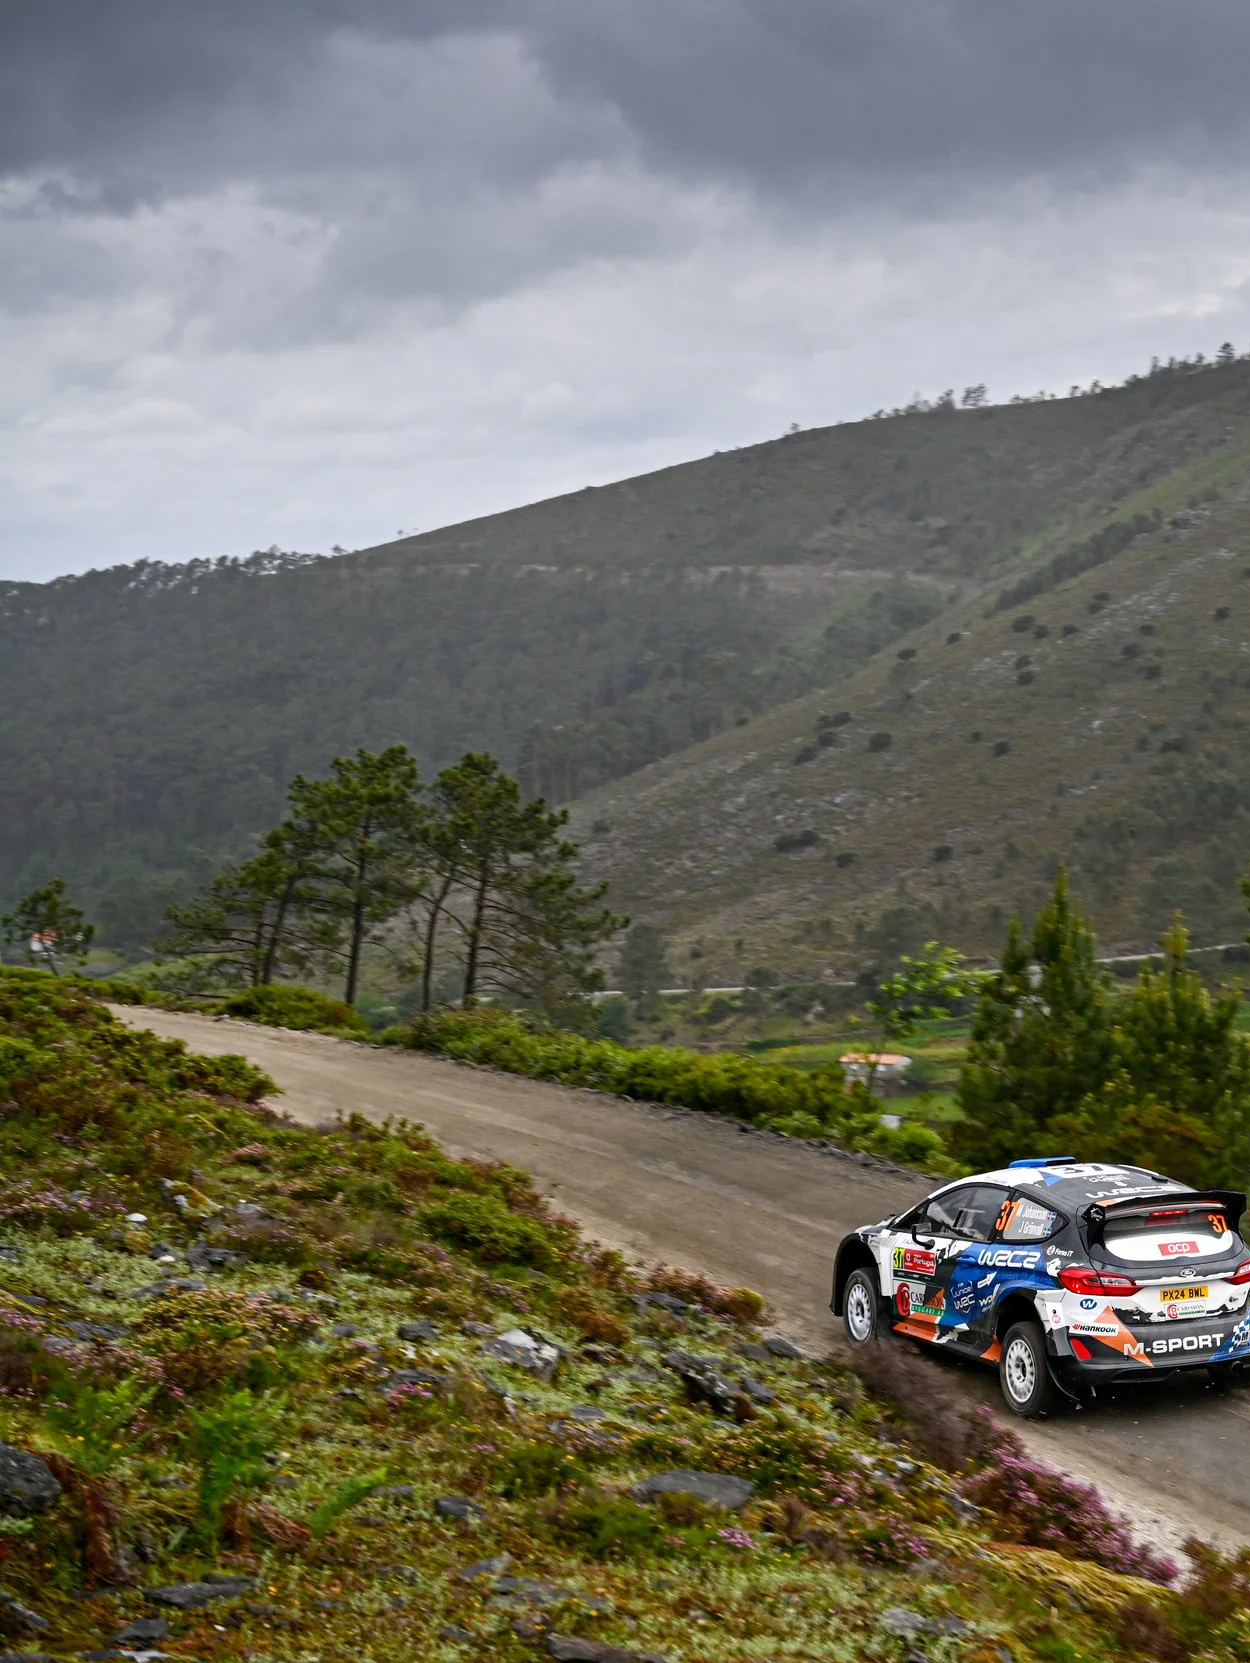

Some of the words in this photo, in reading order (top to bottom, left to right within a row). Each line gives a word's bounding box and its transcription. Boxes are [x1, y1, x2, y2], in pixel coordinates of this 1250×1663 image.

[996, 1200, 1021, 1231] 37
[1022, 1205, 1048, 1220] Johansson
[1208, 1214, 1229, 1233] 37
[1168, 1243, 1190, 1254] acp
[893, 1248, 904, 1268] 37
[913, 1257, 934, 1268] Portugal
[1162, 1290, 1185, 1301] PX24
[1123, 1333, 1224, 1355] M-SPORT
